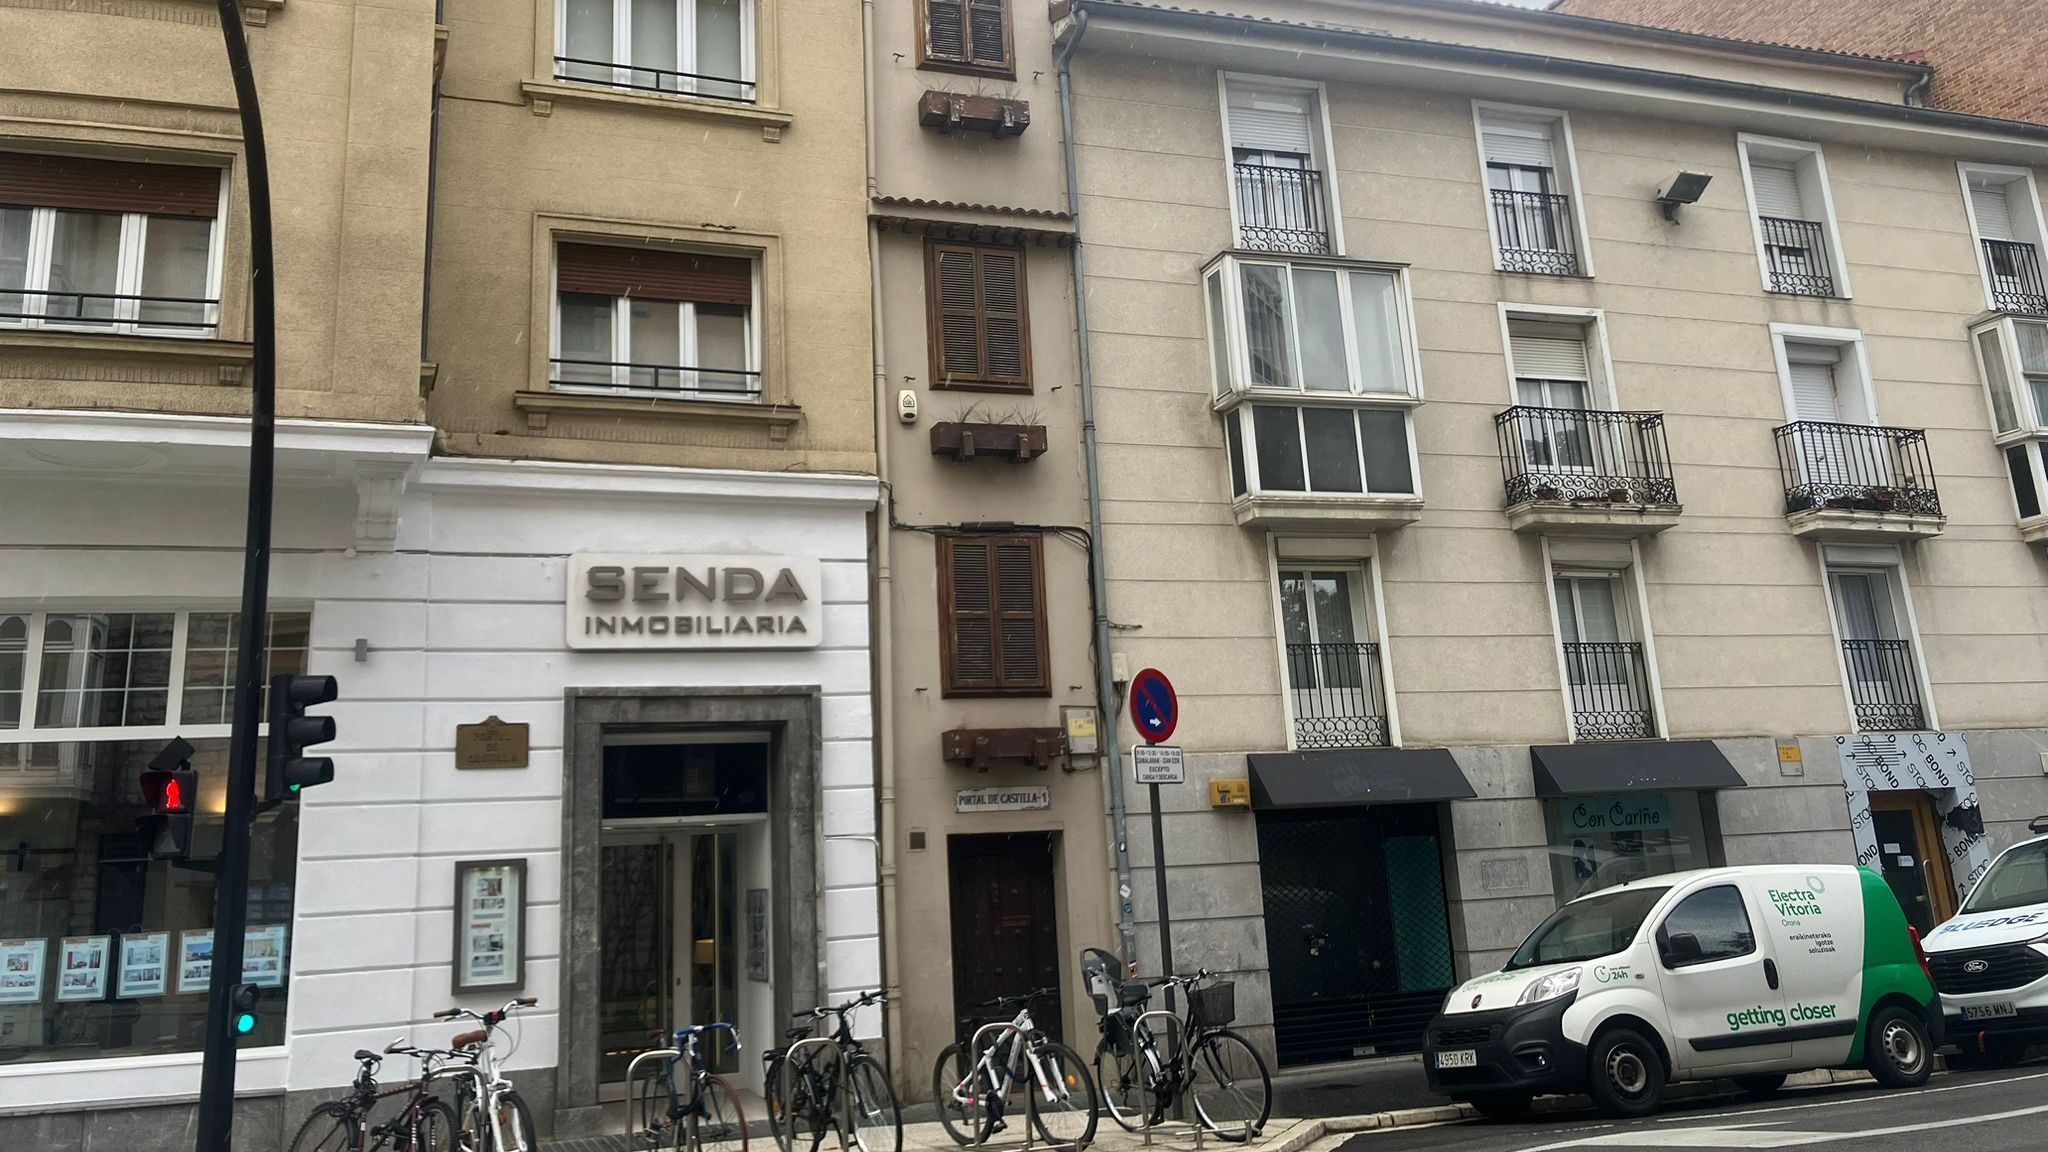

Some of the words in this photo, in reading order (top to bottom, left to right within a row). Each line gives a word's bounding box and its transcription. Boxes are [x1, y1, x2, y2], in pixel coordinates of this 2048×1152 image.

[585, 566, 808, 602] SENDA
[585, 616, 807, 635] INMOBILIARIA
[1925, 753, 1950, 787] BOND
[959, 794, 986, 805] PORTAL
[988, 794, 999, 804] DE
[1572, 803, 1606, 829] Con
[1609, 801, 1661, 827] Cariño
[1768, 889, 1816, 902] Electra
[1775, 901, 1822, 916] Vitoria
[1781, 919, 1801, 927] Orona
[1789, 932, 1832, 941] eraikinetarako
[1815, 939, 1834, 948] igotze
[1808, 946, 1836, 954] soluzioak
[1611, 970, 1629, 980] 24h
[1790, 1003, 1837, 1021] closer
[1967, 1006, 1992, 1017] 5756
[1993, 1002, 2014, 1015] MNJ
[1726, 1005, 1787, 1031] getting
[1440, 1053, 1459, 1066] 4950
